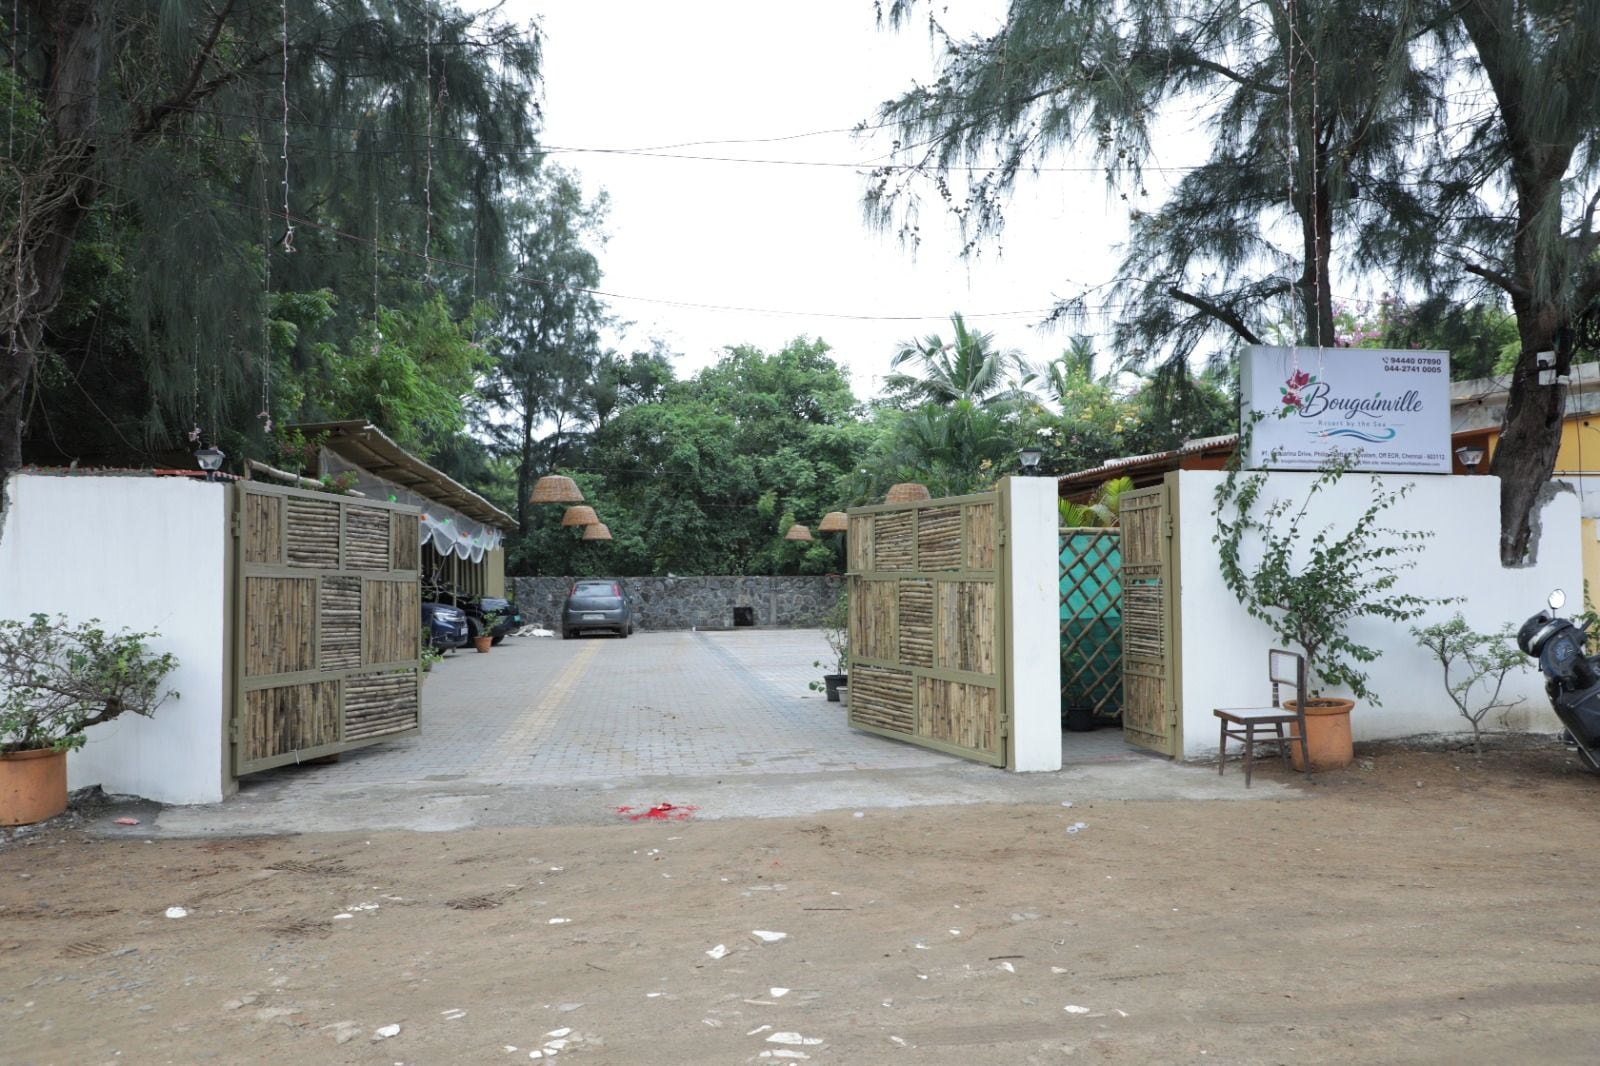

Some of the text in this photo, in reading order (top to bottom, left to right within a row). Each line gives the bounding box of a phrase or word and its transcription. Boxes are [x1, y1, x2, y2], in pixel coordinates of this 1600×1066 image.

[1391, 357, 1442, 366] 94440 07890
[1299, 382, 1423, 420] Bougainville
[1346, 420, 1354, 428] by
